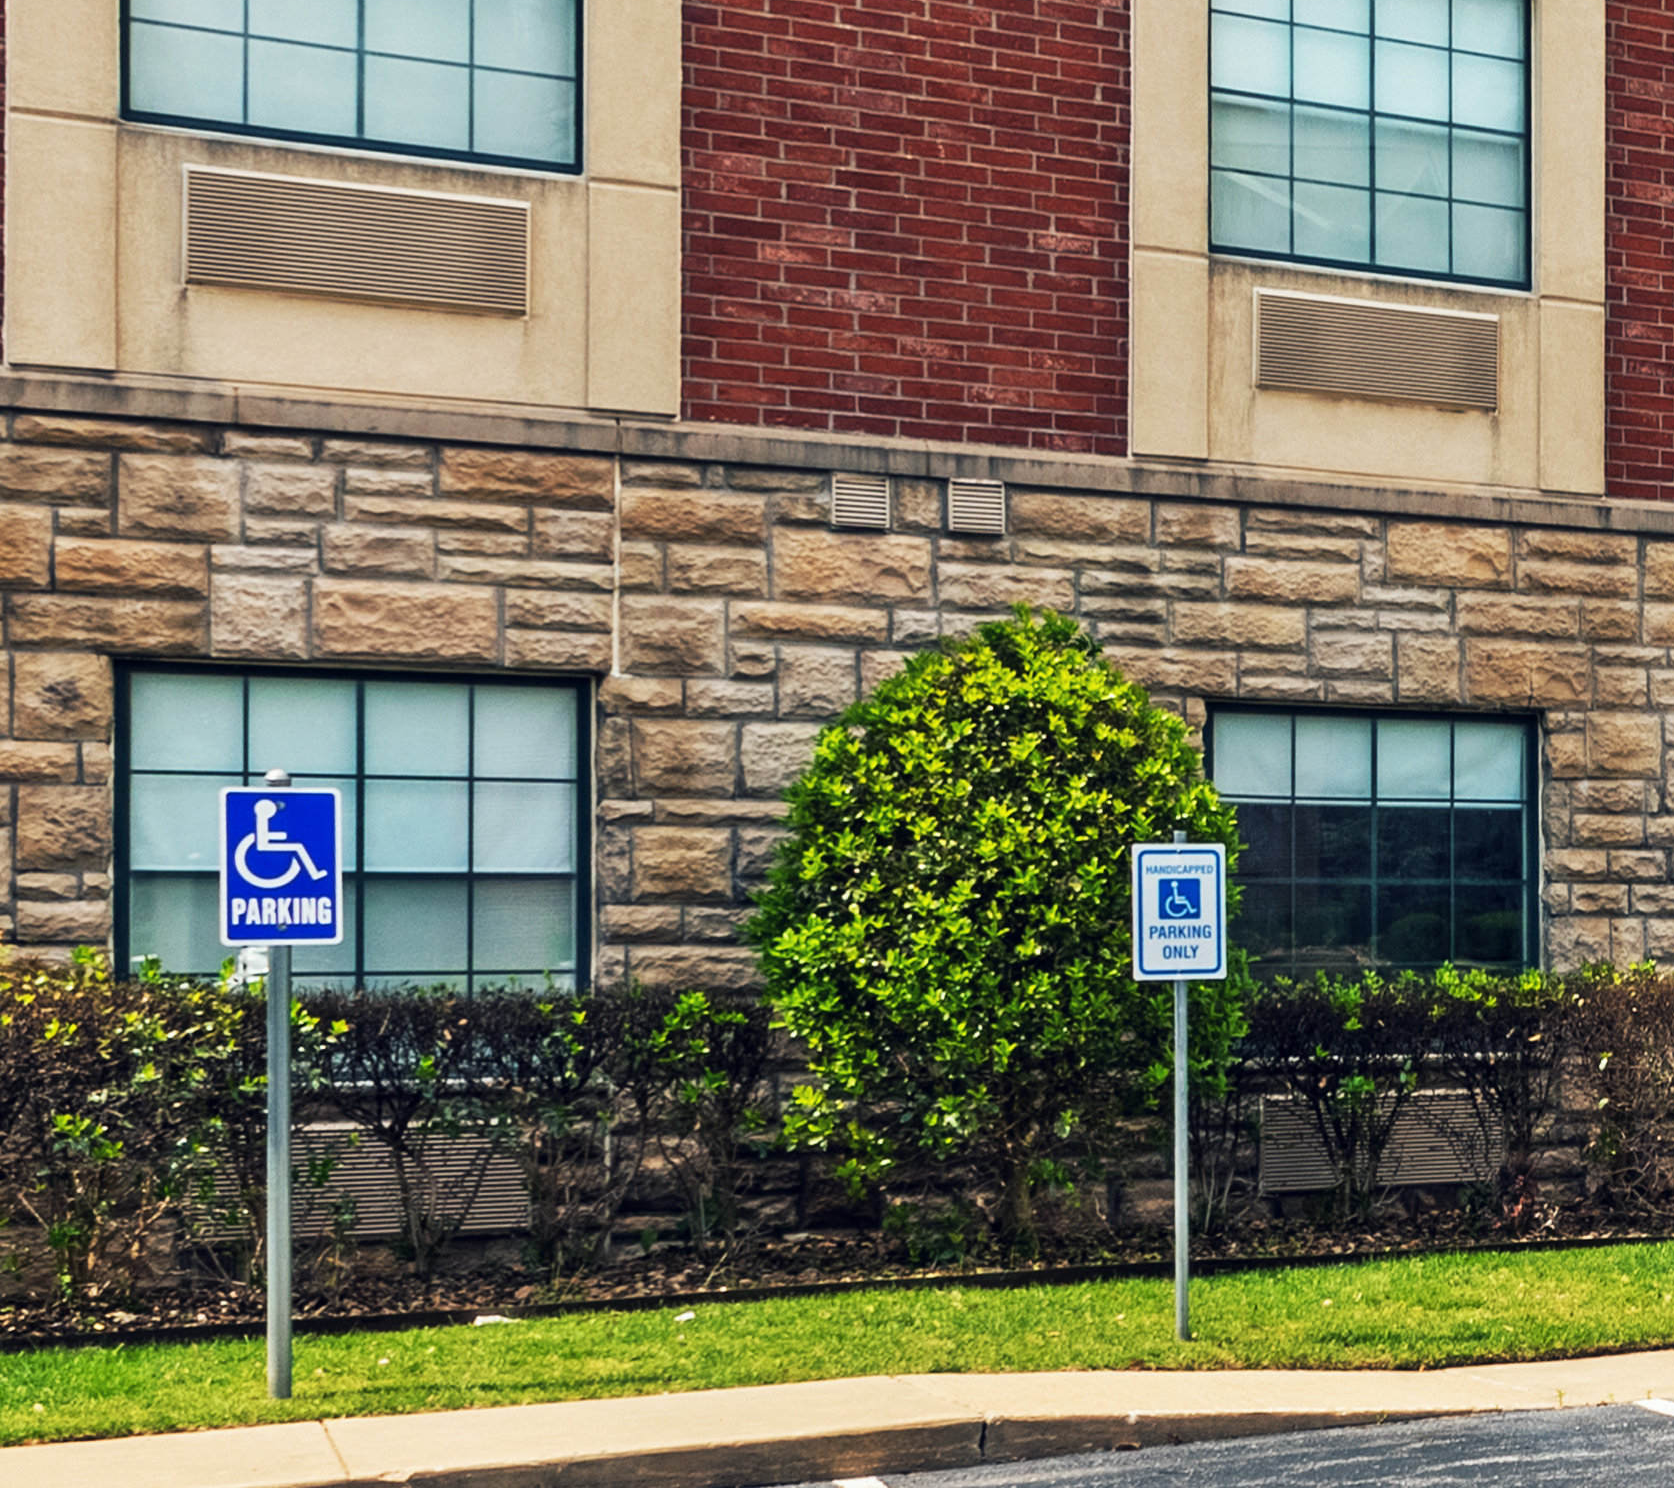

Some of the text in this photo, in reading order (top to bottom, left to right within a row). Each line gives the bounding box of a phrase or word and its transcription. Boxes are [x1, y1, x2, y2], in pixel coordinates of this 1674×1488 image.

[1146, 865, 1213, 874] HANDICAPPED
[231, 896, 332, 925] PARKING
[1149, 925, 1212, 939] PARKING
[1162, 945, 1199, 959] ONLY
